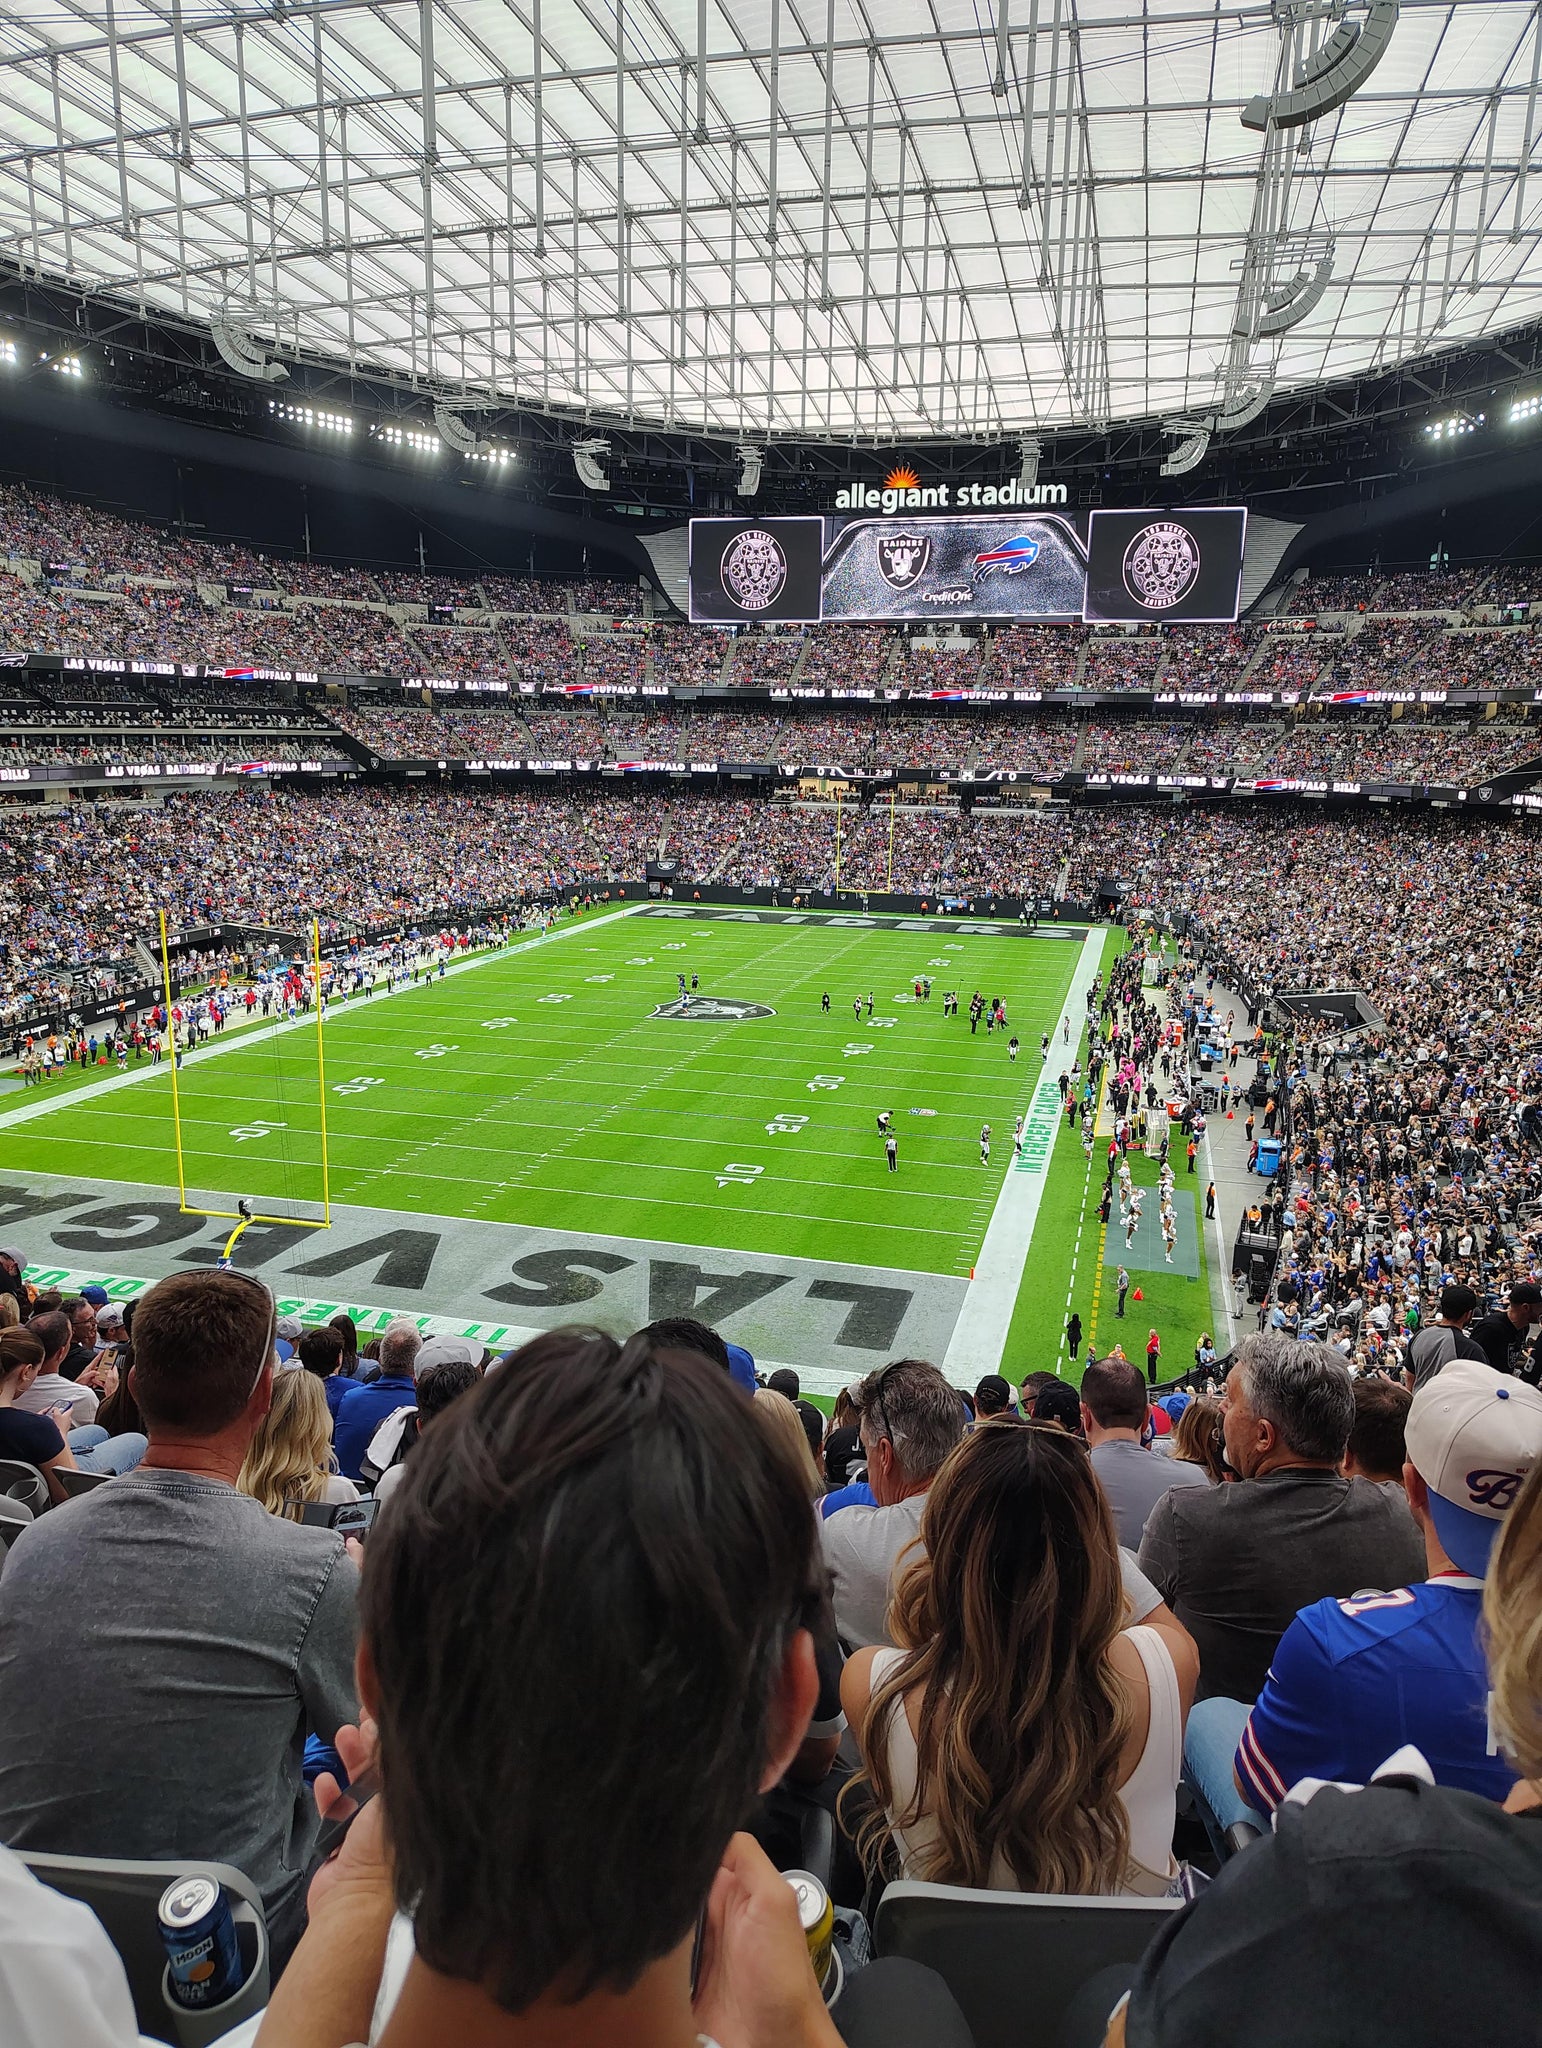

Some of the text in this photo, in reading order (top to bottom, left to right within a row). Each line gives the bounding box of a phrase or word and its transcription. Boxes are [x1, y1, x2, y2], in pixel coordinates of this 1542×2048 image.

[835, 478, 1068, 514] allegiant stadium
[882, 540, 924, 548] RAIDERS
[64, 657, 176, 675] LAS VEGAS RAIDERS
[253, 669, 319, 683] BUFFALO BILLS
[401, 679, 508, 691] LAS VEGAS RAIDERS
[592, 685, 669, 695] BUFFALO BILLS
[769, 688, 876, 698] LAS VEGAS RAIDERS
[962, 691, 1042, 701] BUFFALO BILLS
[1153, 692, 1273, 703] LAS VEGAS RAIDERS
[1366, 691, 1447, 702] BUFFALO BILLS
[105, 763, 206, 778] LAS VEGAS RAIDERS
[262, 760, 322, 772] BUFFALO BILLS
[464, 759, 572, 770] LAS VEGAS RAIDERS
[640, 761, 718, 773] BUFFALO BILLS
[1085, 774, 1207, 787] LAS VEGAS RAIDERS
[1280, 780, 1361, 793] BUFFALO BILLS
[645, 908, 1073, 938] RAIDERS
[332, 1076, 386, 1094] 20
[229, 1119, 289, 1139] 10
[764, 1113, 811, 1134] 20
[1014, 1082, 1061, 1173] INTERCEPT CANCER
[714, 1163, 766, 1185] 10
[480, 1249, 915, 1351] LAS
[175, 1938, 213, 1965] MOON
